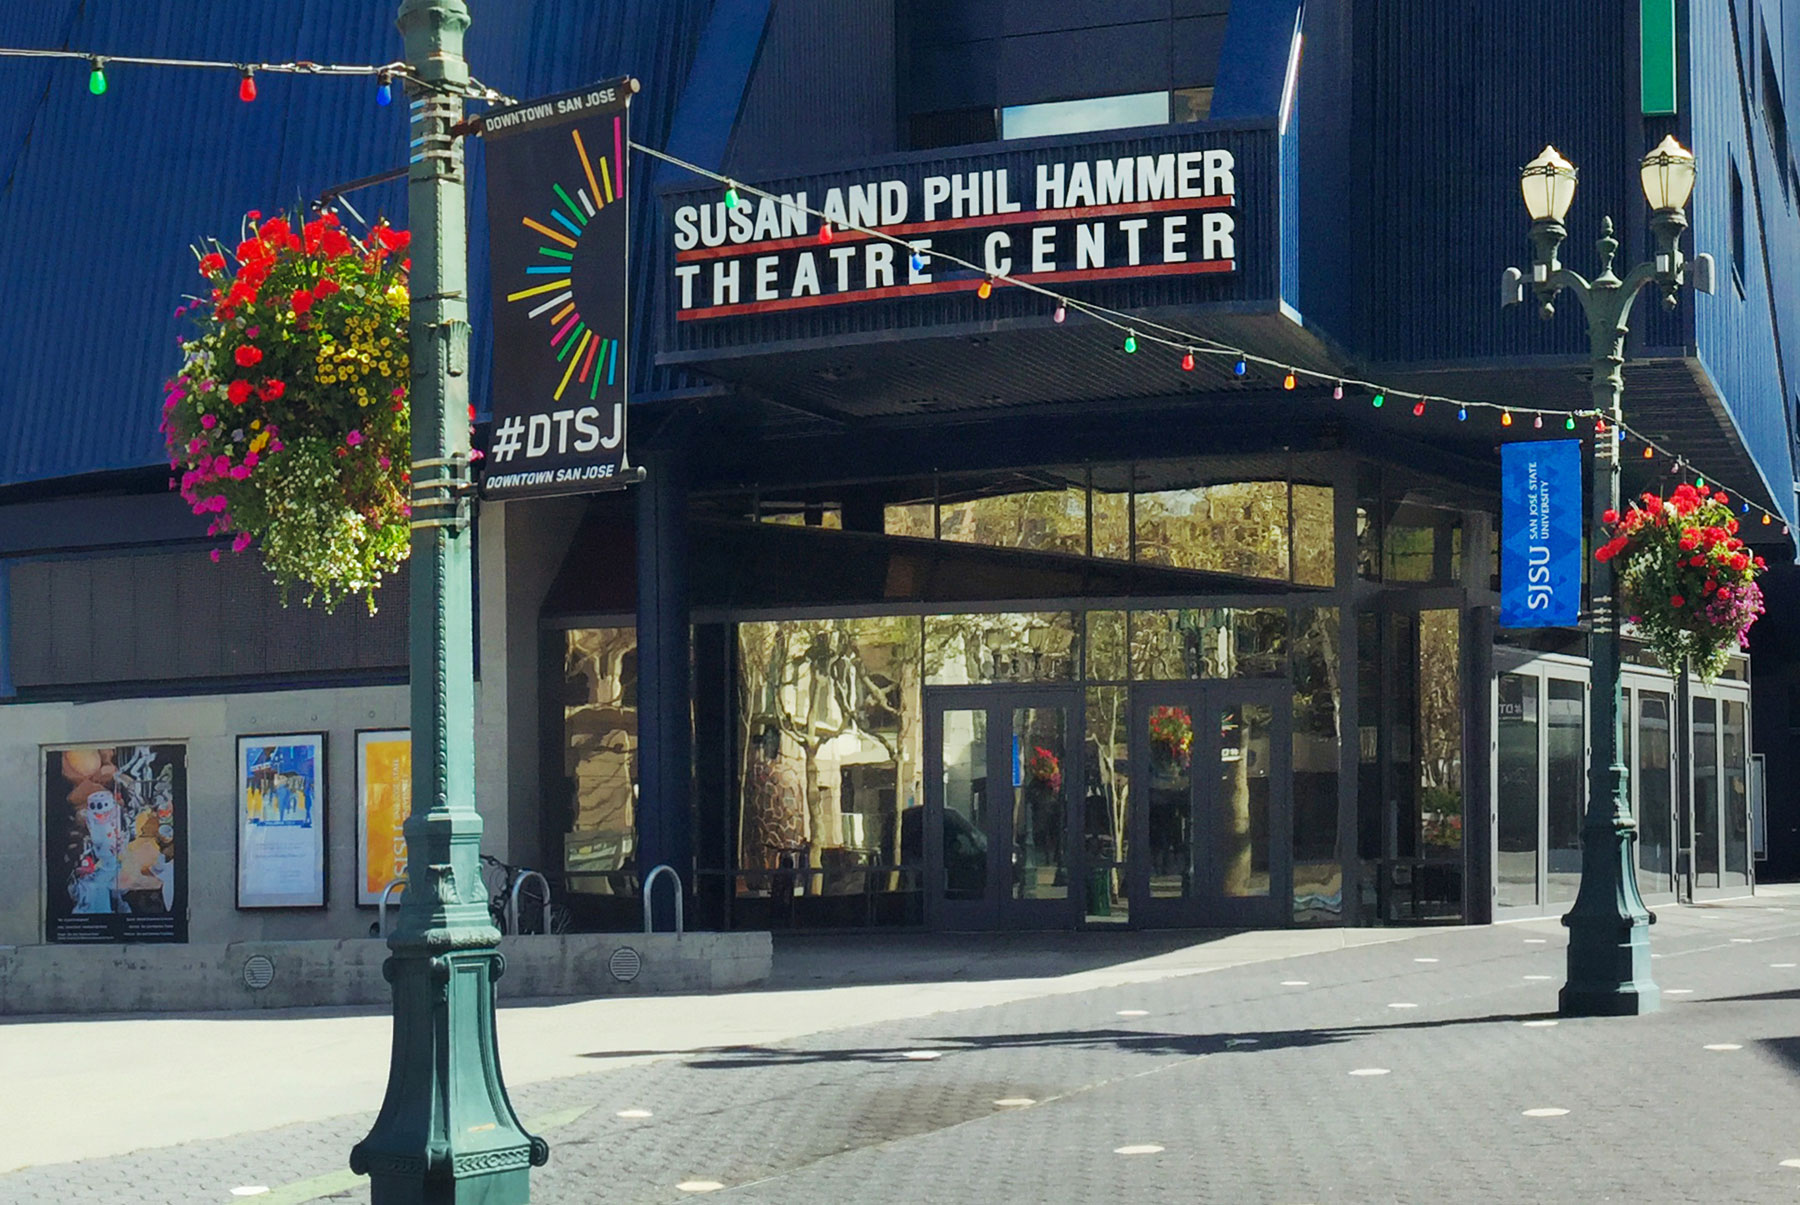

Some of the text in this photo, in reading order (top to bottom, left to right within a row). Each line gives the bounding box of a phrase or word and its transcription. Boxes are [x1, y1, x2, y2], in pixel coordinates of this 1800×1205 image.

[486, 88, 616, 132] DOWNTOWN SAN JOSE
[674, 149, 1235, 250] SUSAN AND PHIL HAMMER
[675, 212, 1235, 309] THEATRE CENTER
[492, 403, 622, 462] #DTSJ
[486, 464, 615, 489] DOWNTOWN SAN JOSE
[1527, 462, 1538, 540] SAN JOSÉ STATE
[1541, 480, 1549, 539] UNIVERSITY
[1527, 545, 1553, 609] SJSU
